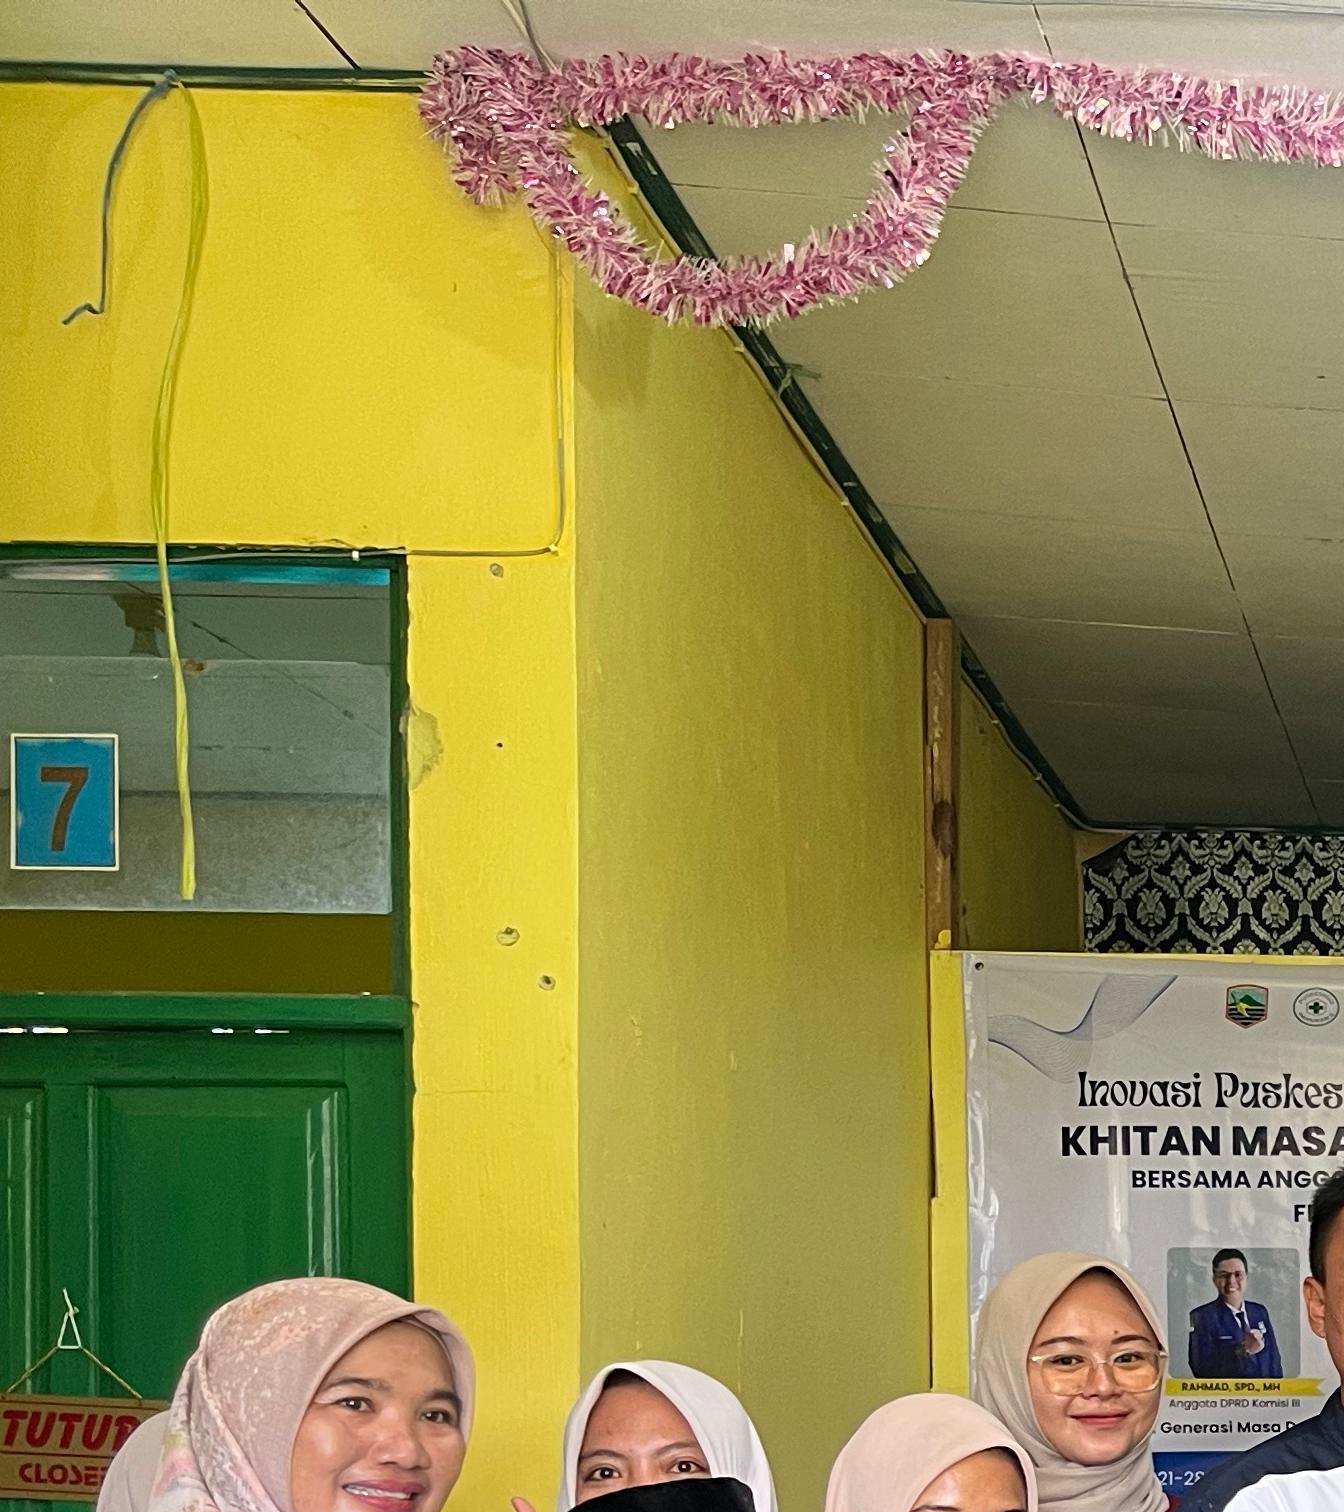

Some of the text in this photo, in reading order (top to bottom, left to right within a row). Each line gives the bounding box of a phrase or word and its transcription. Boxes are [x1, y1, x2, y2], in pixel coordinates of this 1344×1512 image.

[40, 766, 89, 852] 7
[1077, 1071, 1202, 1108] Inovasi
[1061, 1125, 1221, 1157] KHITAN
[1132, 1170, 1251, 1189] BERSAMA
[1181, 1382, 1231, 1393] RAHMAD,
[1263, 1382, 1281, 1392] MH
[1169, 1398, 1217, 1411] Anggota
[1220, 1398, 1249, 1409] DPRD
[1252, 1398, 1289, 1408] Komisi
[1160, 1420, 1233, 1434] Generasi
[1238, 1421, 1281, 1434] Masa
[18, 1462, 108, 1487] CLOSE
